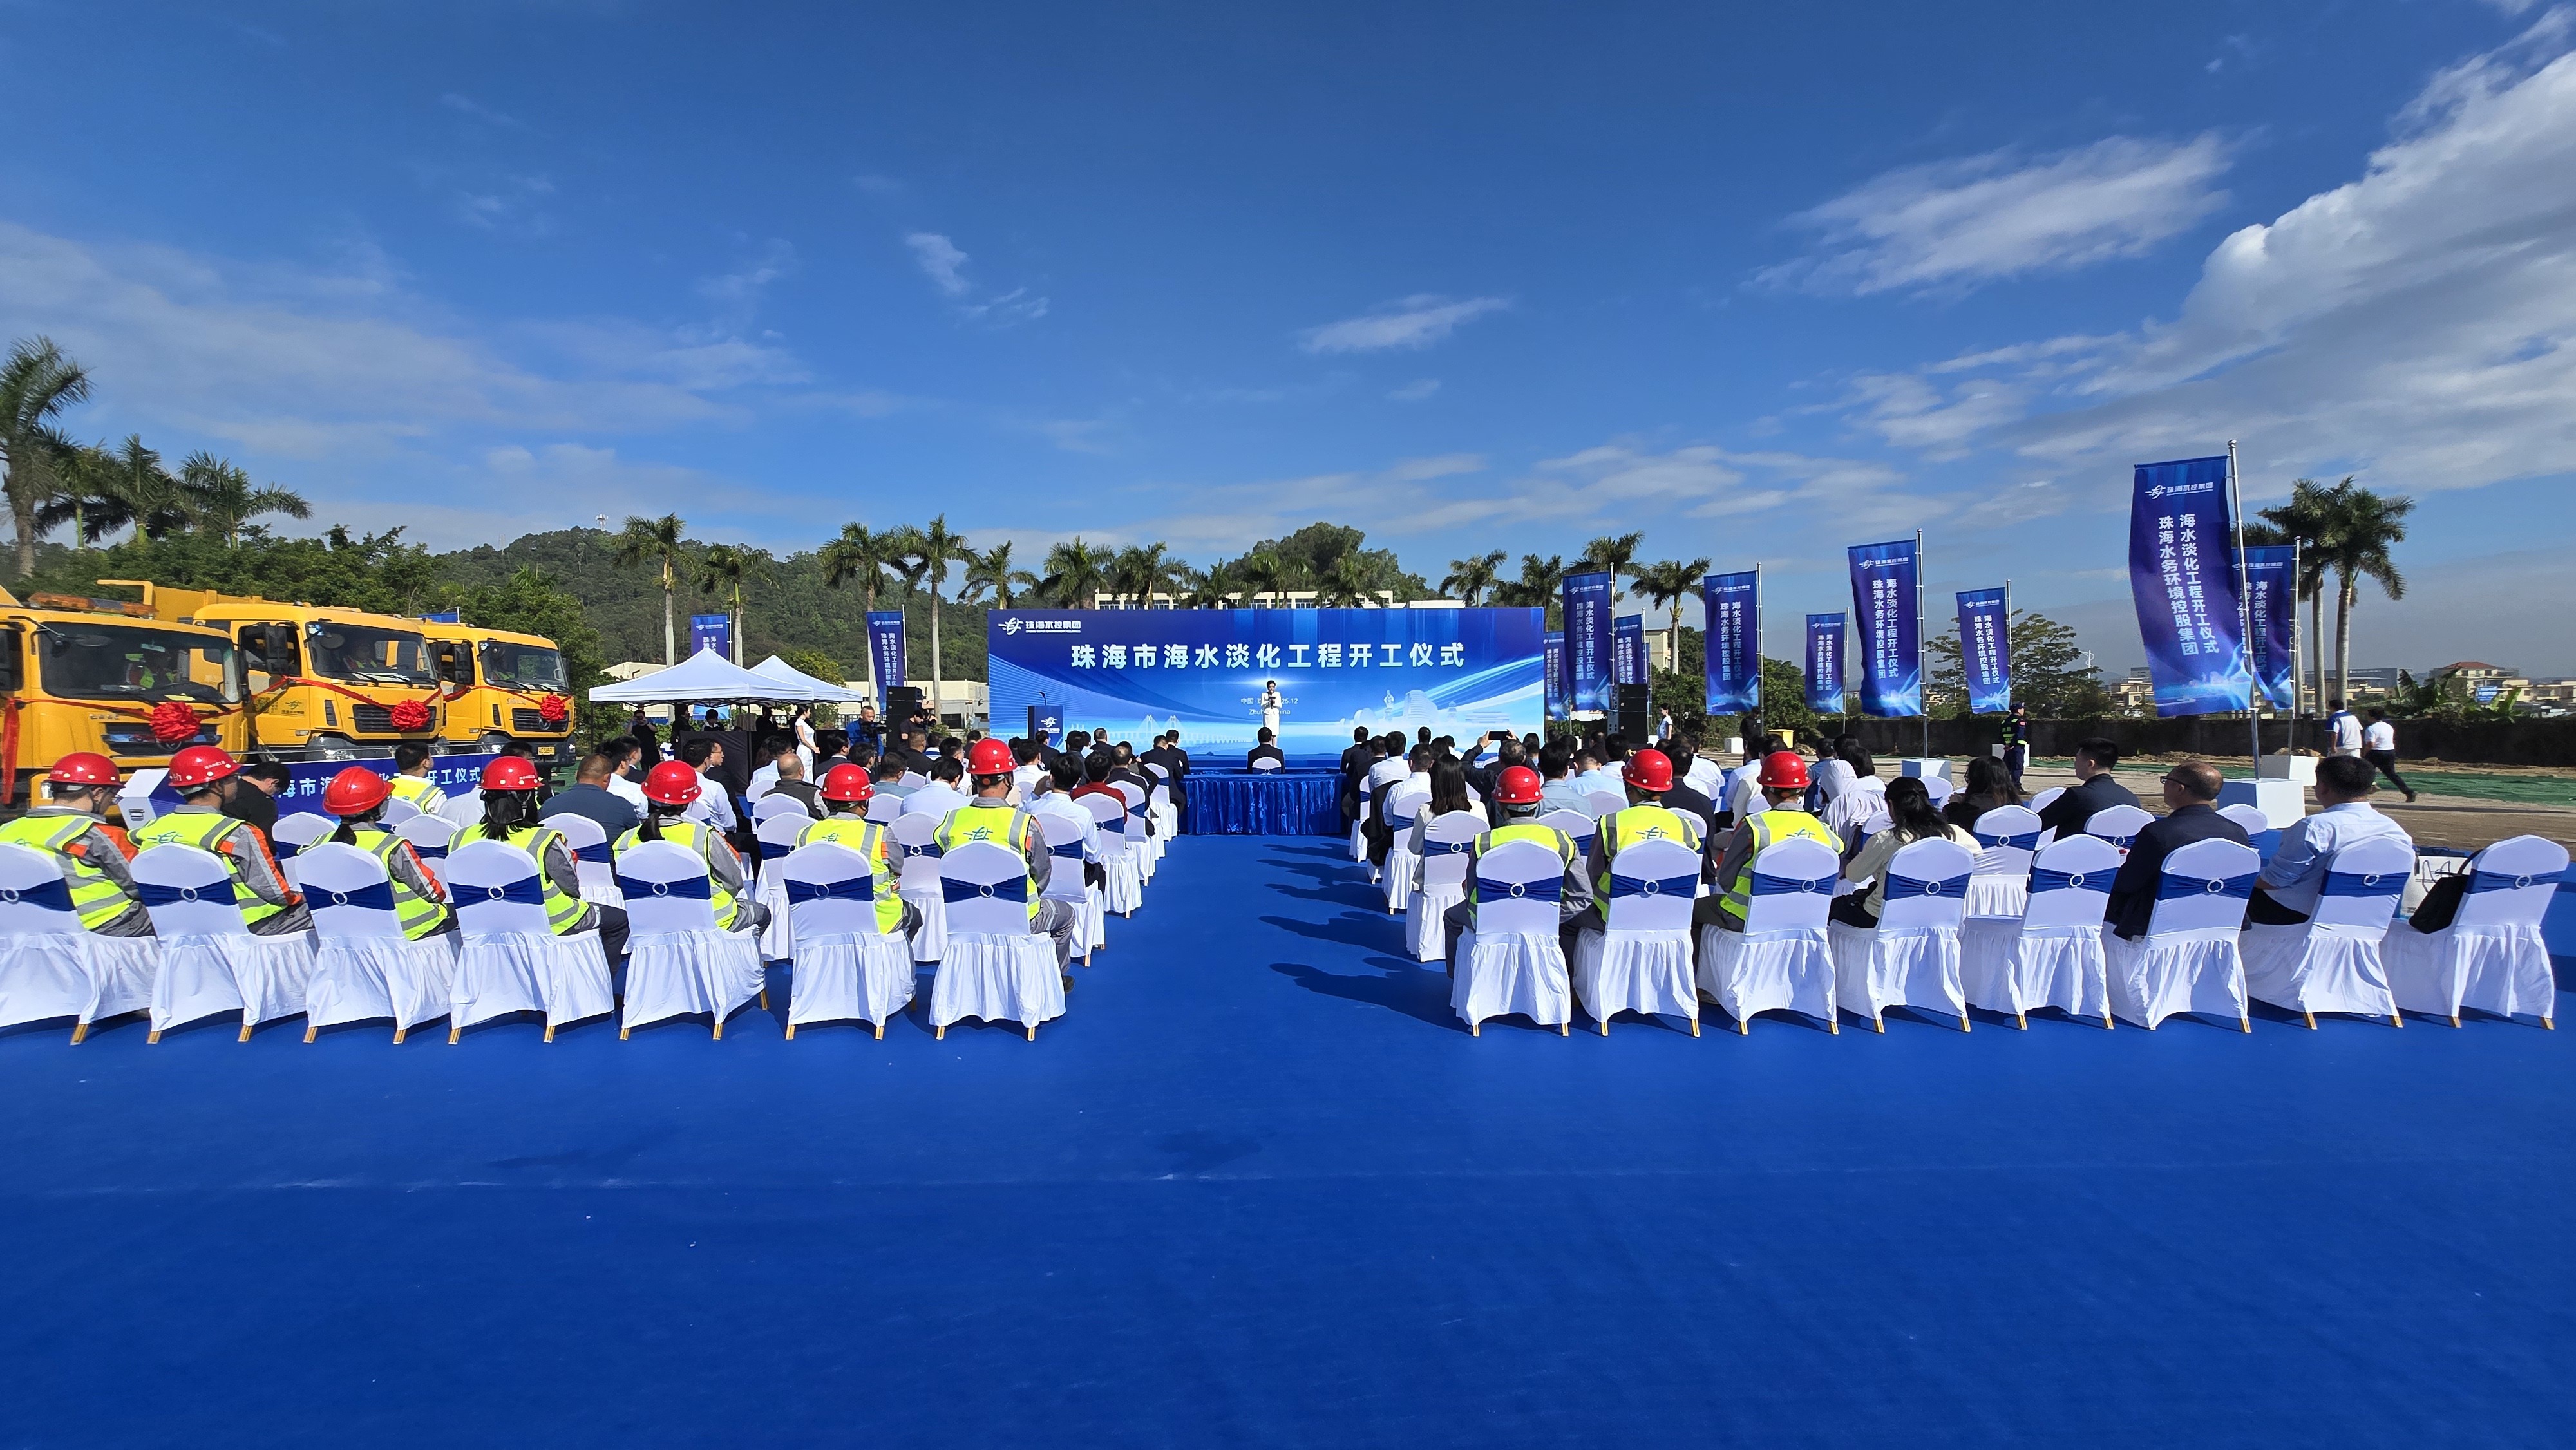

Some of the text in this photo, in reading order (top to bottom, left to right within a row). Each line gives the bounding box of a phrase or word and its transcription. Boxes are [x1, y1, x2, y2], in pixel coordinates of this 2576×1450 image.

[1872, 579, 1886, 679] 珠海水务环境控股集团
[1886, 579, 1899, 678] 海水淡化工程开工仪式
[2159, 516, 2199, 656] 珠海水务环境控股集团
[2179, 514, 2220, 654] 海水淡化工程开工仪式
[2254, 581, 2268, 673] 海水淡化工程开工仪式
[1071, 643, 1464, 669] 珠海市海水淡化工程开工仪式
[1586, 601, 1595, 679] 海水淡化工程开工仪式
[1720, 602, 1731, 681] 珠海水务环境控股集团
[1984, 615, 2000, 684] 海水淡化工程开工仪式
